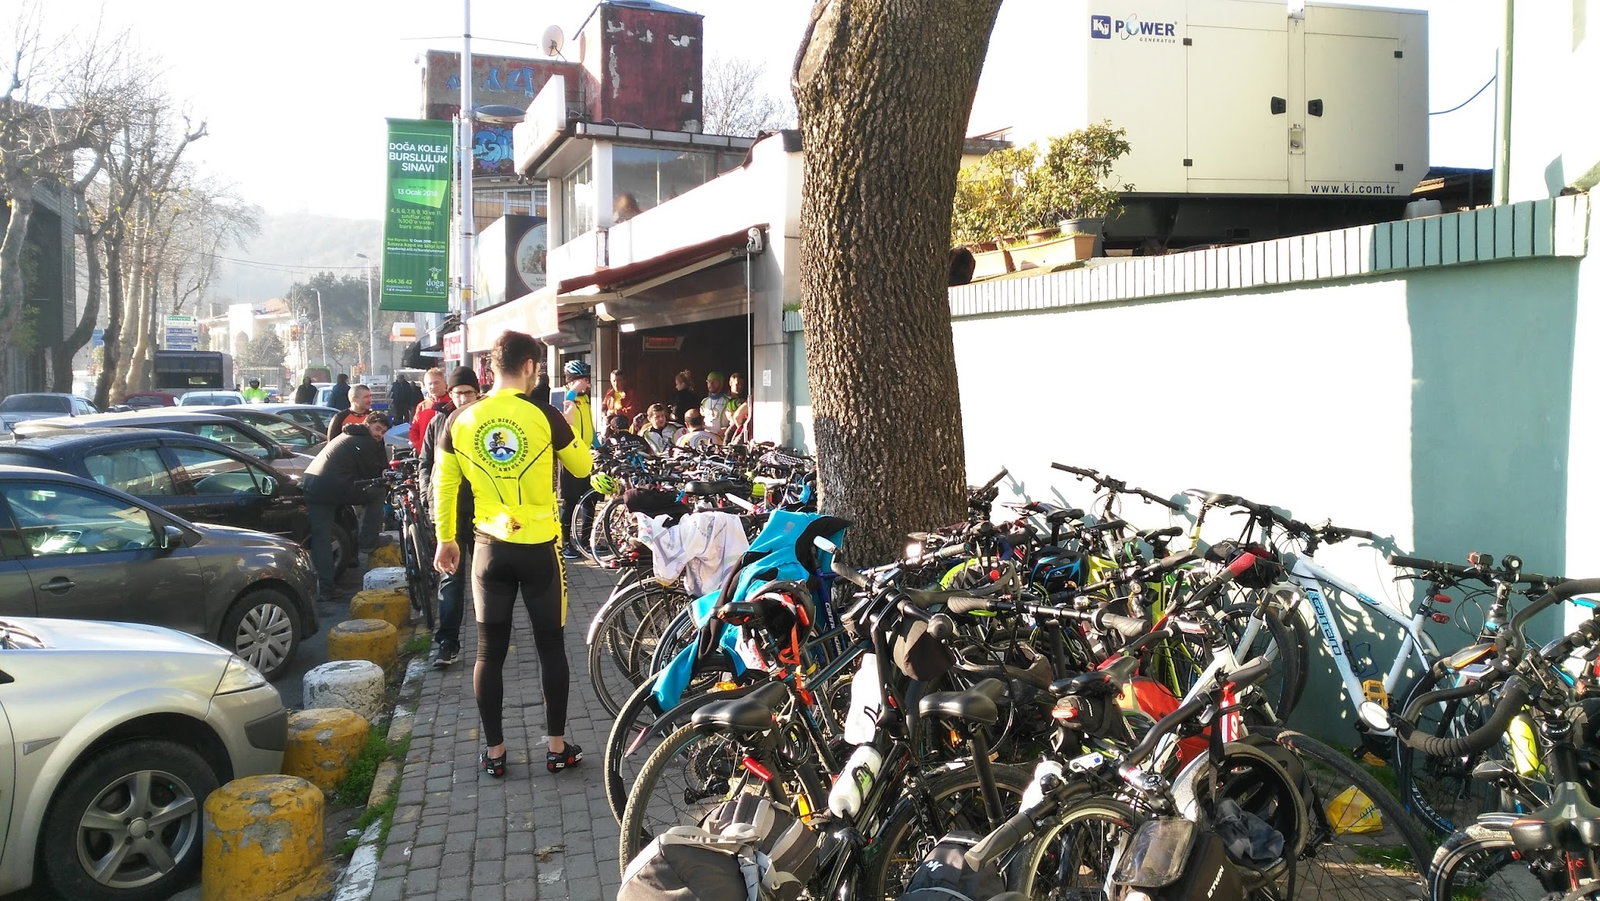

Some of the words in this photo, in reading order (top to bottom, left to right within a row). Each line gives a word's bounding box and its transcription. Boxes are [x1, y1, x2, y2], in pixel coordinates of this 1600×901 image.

[1115, 19, 1175, 37] POWER
[389, 142, 416, 151] DOĞA
[417, 144, 448, 154] KOLEJİ
[388, 152, 448, 164] BURSLULUK
[401, 162, 435, 172] SINAVI
[1310, 183, 1395, 194] www.kj.com.tr
